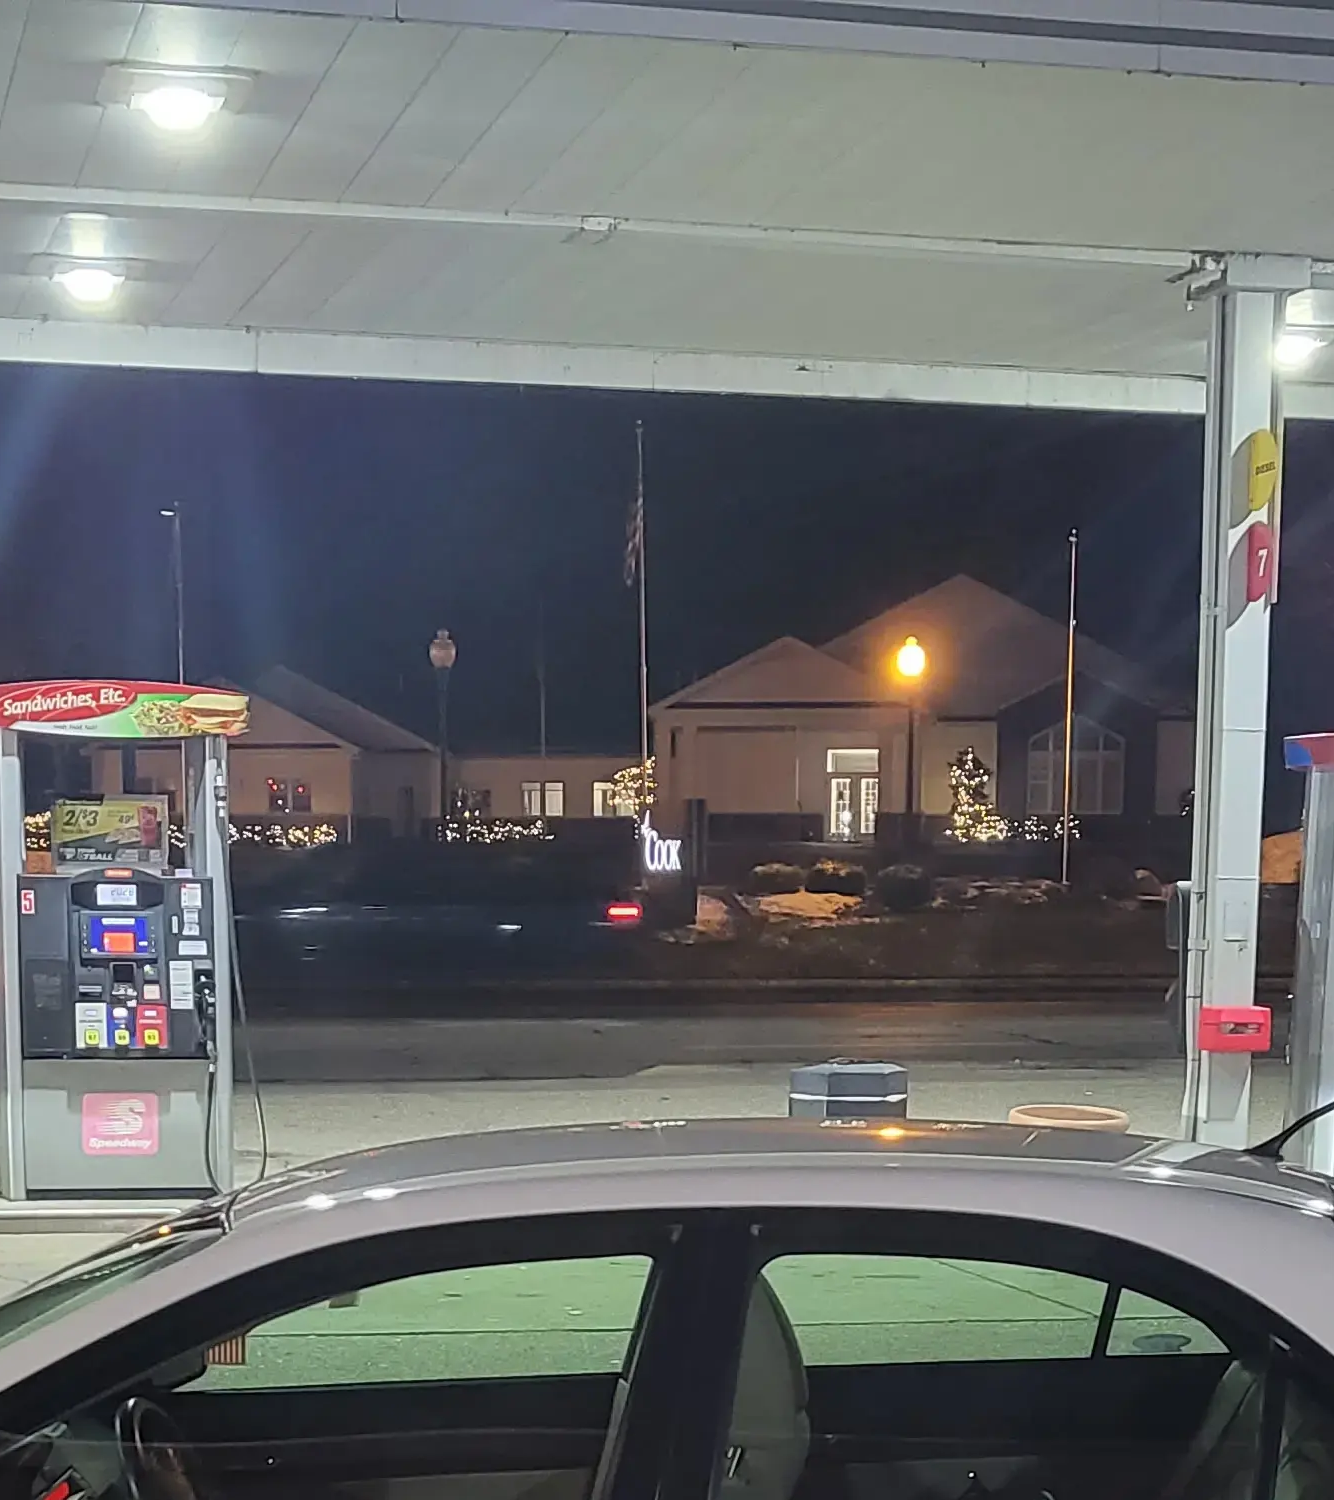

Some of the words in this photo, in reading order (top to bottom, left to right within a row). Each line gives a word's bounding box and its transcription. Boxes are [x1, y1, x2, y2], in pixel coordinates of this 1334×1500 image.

[1255, 461, 1276, 475] DIESEL
[1257, 548, 1268, 577] 7
[3, 691, 97, 717] Sandwiches,
[100, 688, 126, 704] Etc.
[63, 808, 99, 827] 2/$3
[23, 892, 33, 911] 5
[89, 1137, 152, 1149] Speedway
